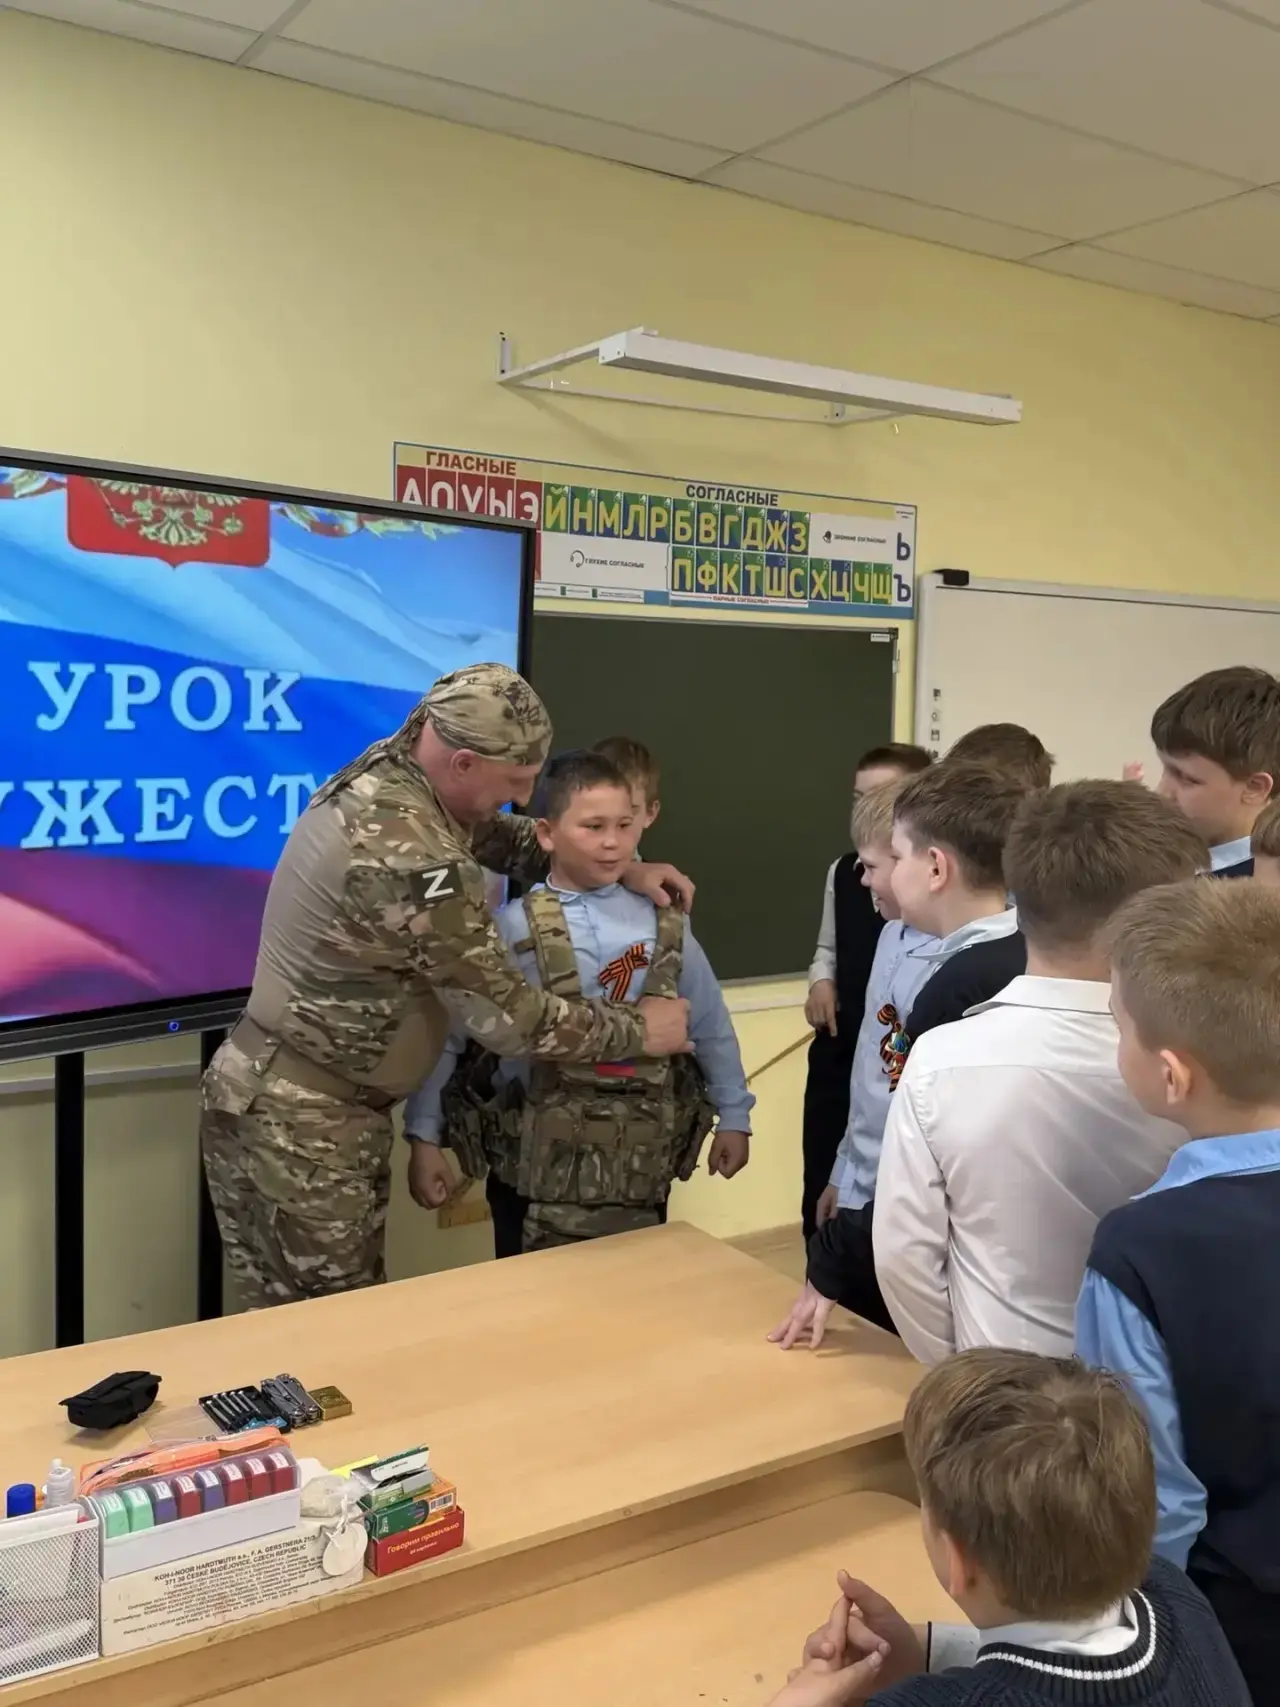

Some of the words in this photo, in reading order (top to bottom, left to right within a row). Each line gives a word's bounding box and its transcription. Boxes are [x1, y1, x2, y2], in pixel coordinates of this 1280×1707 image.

[426, 450, 517, 476] ГЛАСНЫЕ
[686, 484, 779, 507] СОГЛАСНЫЕ
[27, 661, 303, 732] УРОК
[0, 772, 333, 849] ЖЕСТ
[421, 867, 454, 899] Z
[387, 1537, 420, 1553] Говорим
[421, 1522, 460, 1542] правильно
[154, 1566, 195, 1581] KOH-I-NOOR
[196, 1555, 237, 1571] HARDTMUTH
[165, 1578, 176, 1586] 371
[253, 1552, 275, 1564] CZECH
[275, 1543, 307, 1558] REPUBLIC
